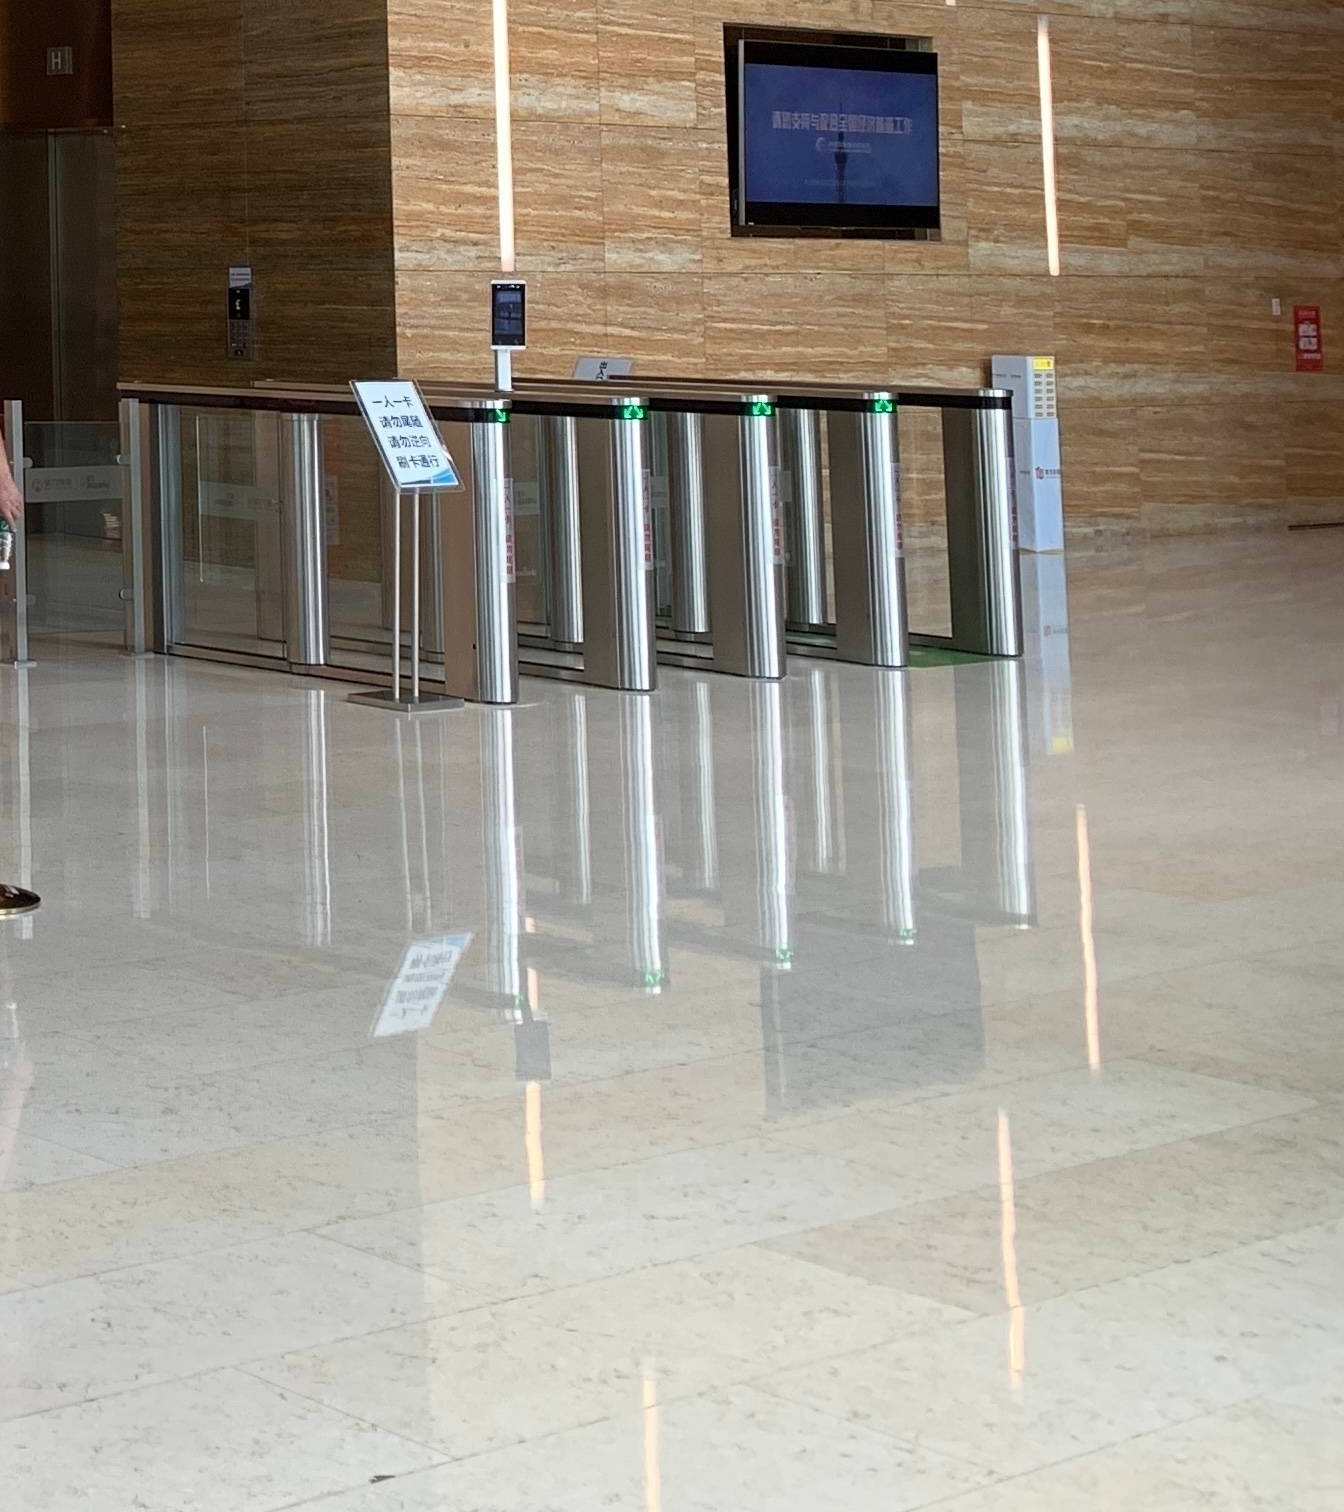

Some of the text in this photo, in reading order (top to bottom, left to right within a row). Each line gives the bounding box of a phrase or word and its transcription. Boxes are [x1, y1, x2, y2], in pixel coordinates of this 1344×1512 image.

[372, 395, 414, 408] 一人一卡
[378, 415, 424, 428] 请勿尾随
[387, 435, 432, 448] 请勿逆向
[396, 454, 440, 469] 刷卡通行
